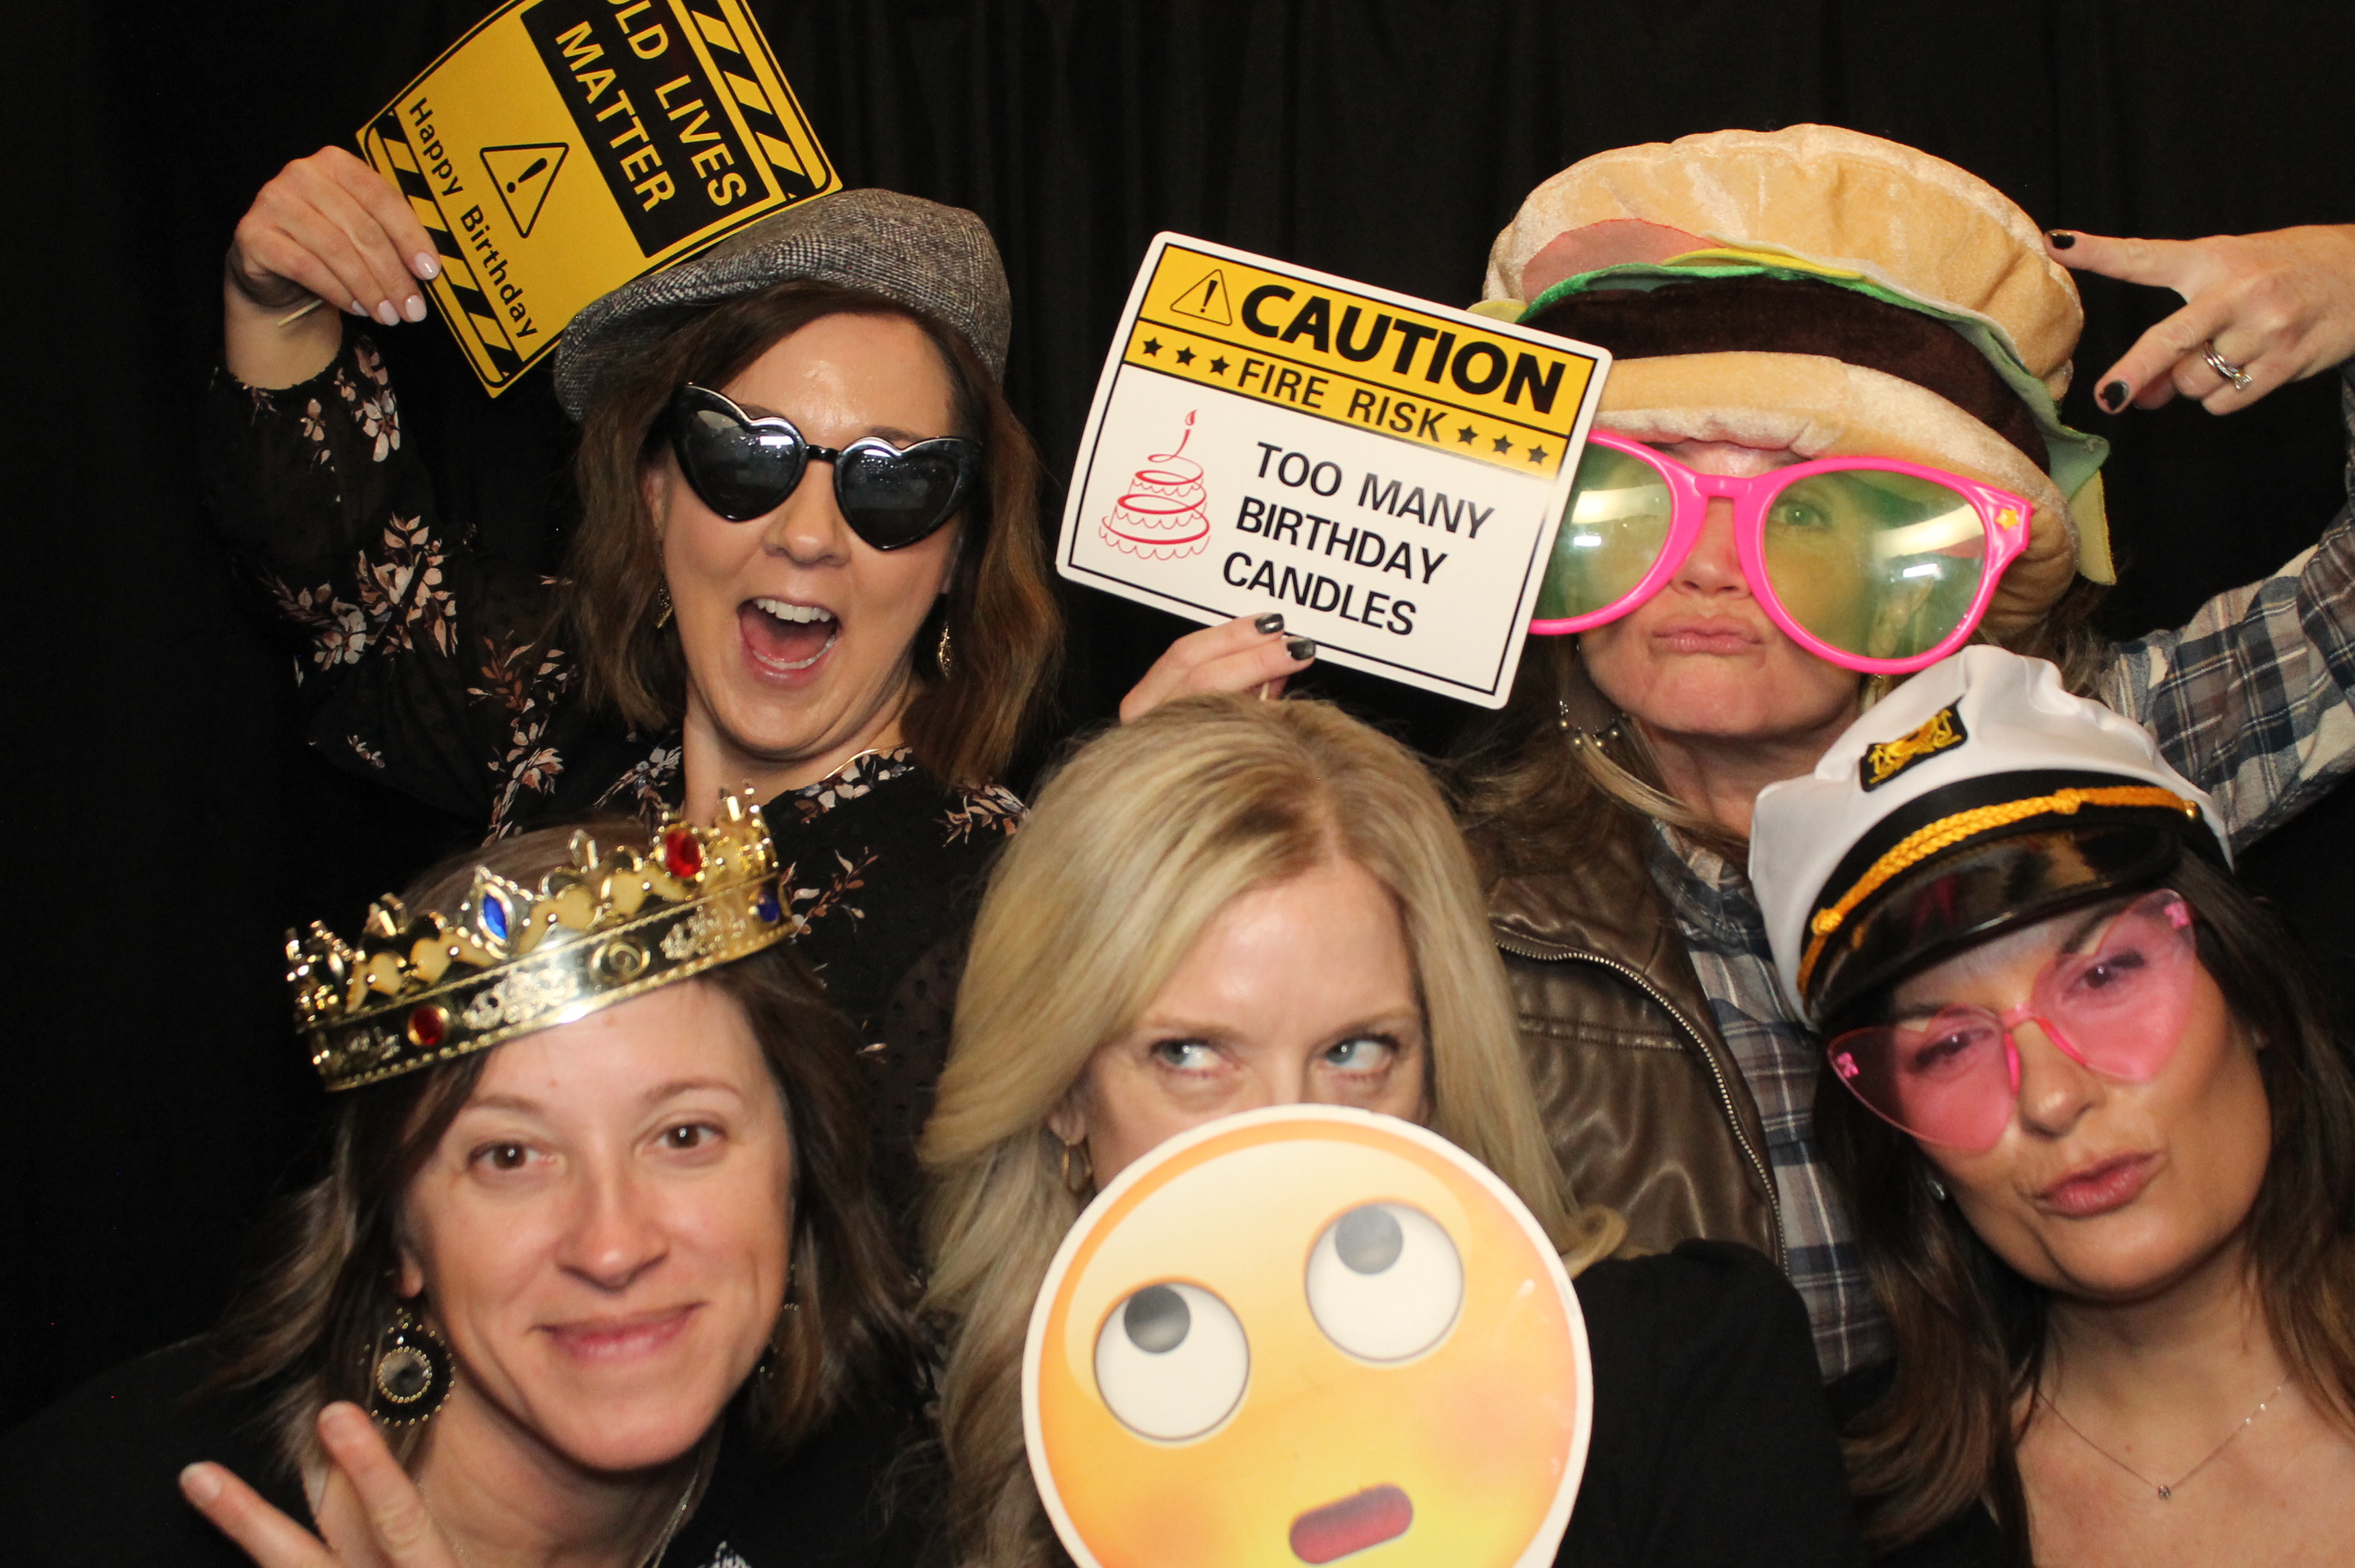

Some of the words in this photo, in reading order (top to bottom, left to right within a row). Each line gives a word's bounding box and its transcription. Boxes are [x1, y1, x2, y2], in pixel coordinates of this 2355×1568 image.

[556, 21, 676, 212] MATTER
[607, 0, 669, 59] LD
[655, 75, 747, 207] LIVES
[410, 98, 463, 197] Happy
[461, 205, 537, 339] Birthday
[1237, 358, 1329, 409] FIRE
[1348, 388, 1447, 442] RISK
[1242, 285, 1566, 413] CAUTION
[1237, 496, 1447, 584] BIRTHDAY
[1257, 442, 1342, 496] TOO
[1357, 473, 1495, 539] MANY
[1224, 552, 1416, 635] CANDLES
